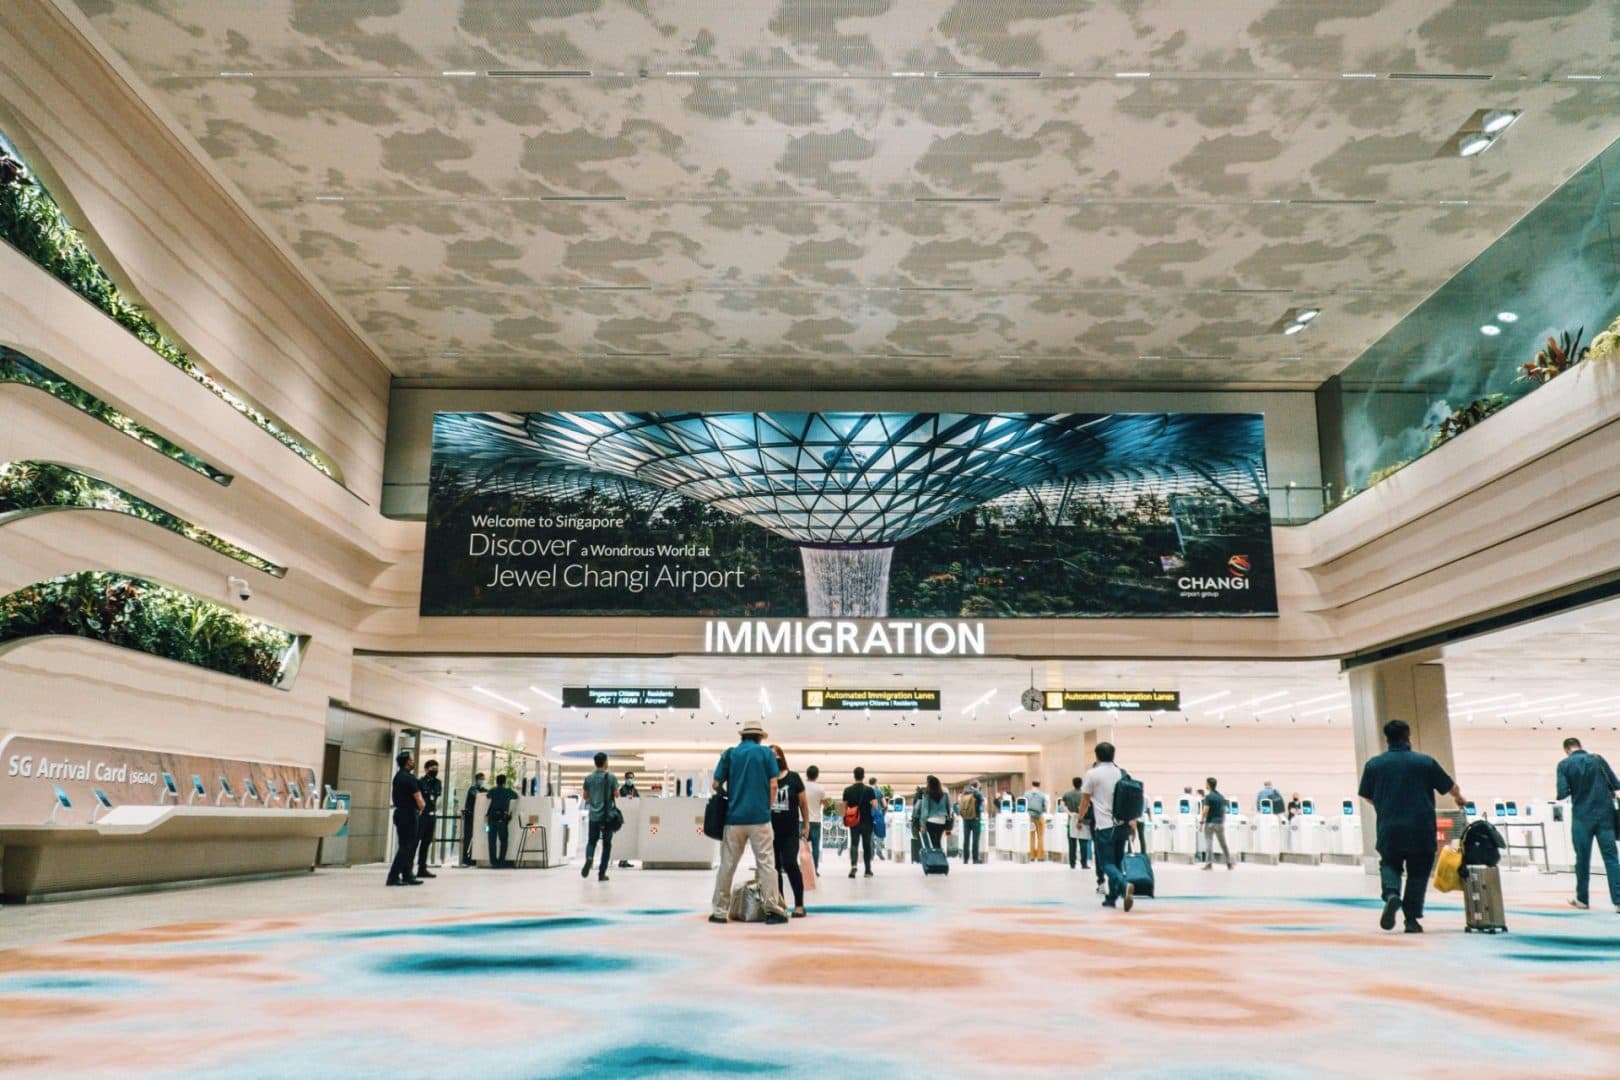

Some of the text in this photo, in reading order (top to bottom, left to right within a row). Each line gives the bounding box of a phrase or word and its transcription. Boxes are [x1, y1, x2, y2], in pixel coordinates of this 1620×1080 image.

[472, 515, 624, 530] Welcome to Singapore
[469, 532, 710, 557] Discover a Wondrous World at
[486, 564, 745, 592] Jewel Changi Airport
[1177, 577, 1250, 590] CHANGI
[704, 620, 985, 655] IMMIGRATION
[825, 691, 935, 701] Automated Immigration Lanes
[1064, 693, 1175, 702] Automated Immigration Lanes
[8, 755, 158, 785] SG Arrival Card (SGAC)
